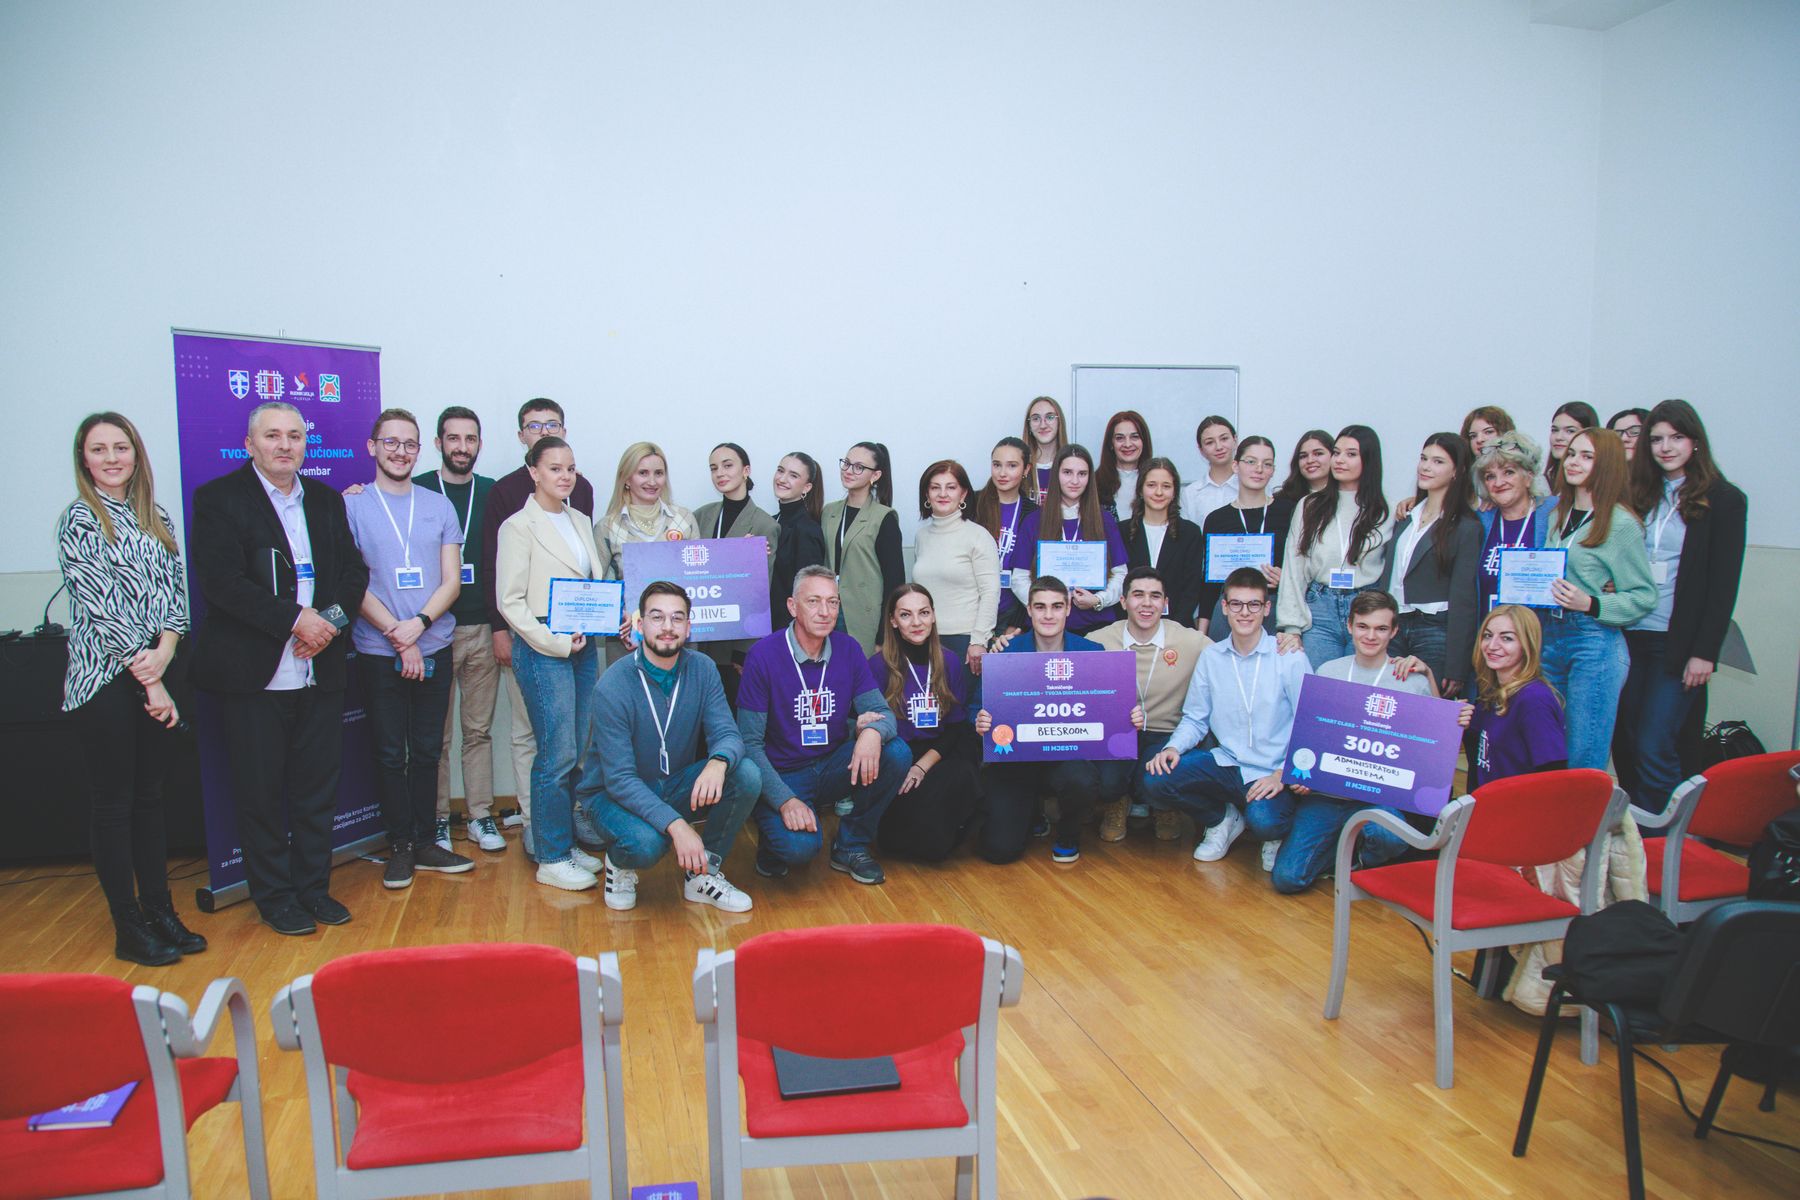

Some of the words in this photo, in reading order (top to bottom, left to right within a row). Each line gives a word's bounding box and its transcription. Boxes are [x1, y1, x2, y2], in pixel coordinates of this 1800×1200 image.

[220, 448, 250, 459] TVOJ
[310, 446, 354, 459] UČIONICA
[298, 466, 331, 476] vembar
[685, 585, 722, 600] 00€
[1033, 702, 1086, 718] 200€
[1037, 726, 1089, 737] BEESROOM
[1337, 720, 1356, 728] CLASS
[1360, 725, 1379, 733] TVOJA
[1050, 744, 1079, 752] MJESTO
[1343, 734, 1401, 760] 300€
[1345, 766, 1385, 782] SISTEMA
[1351, 782, 1382, 794] MJESTO
[334, 812, 351, 822] Pljevlja
[363, 803, 381, 812] Konkur
[220, 860, 228, 868] za
[229, 857, 243, 866] rasp
